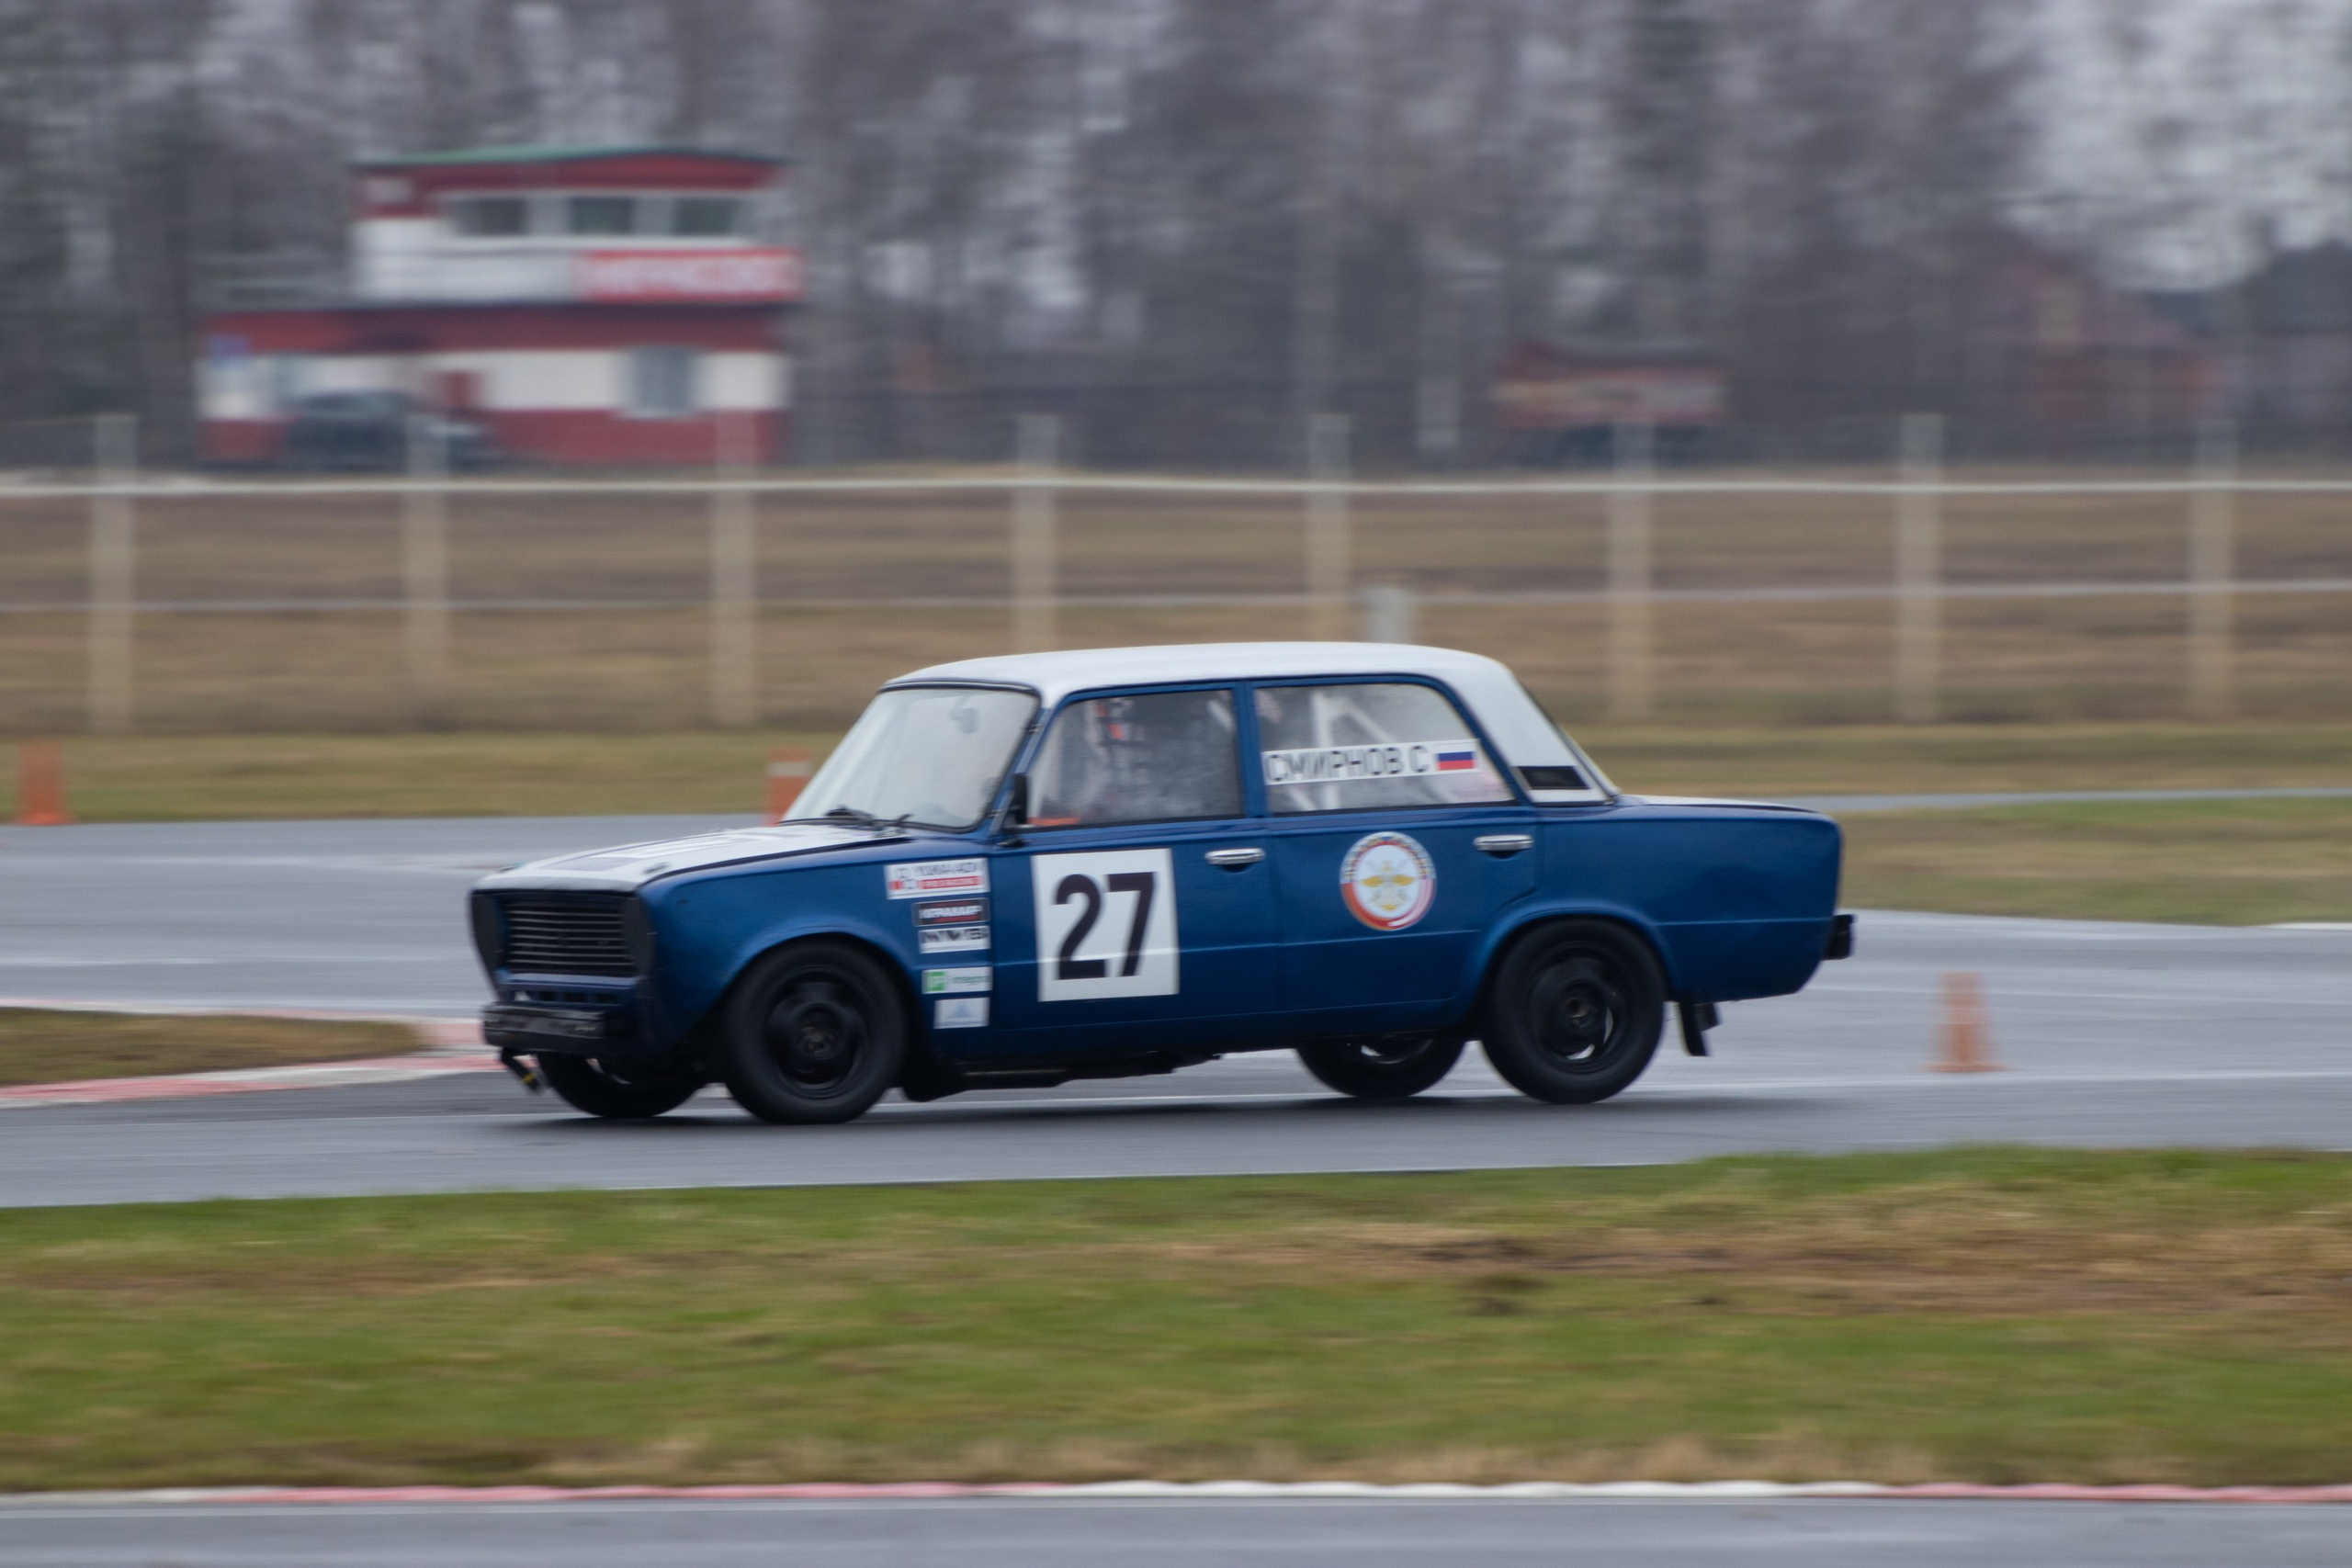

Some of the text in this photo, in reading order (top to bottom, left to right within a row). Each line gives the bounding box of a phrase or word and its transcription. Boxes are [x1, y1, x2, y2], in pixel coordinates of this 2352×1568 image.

[1267, 745, 1428, 782] СМИРНОВ С
[1053, 872, 1158, 980] 27
